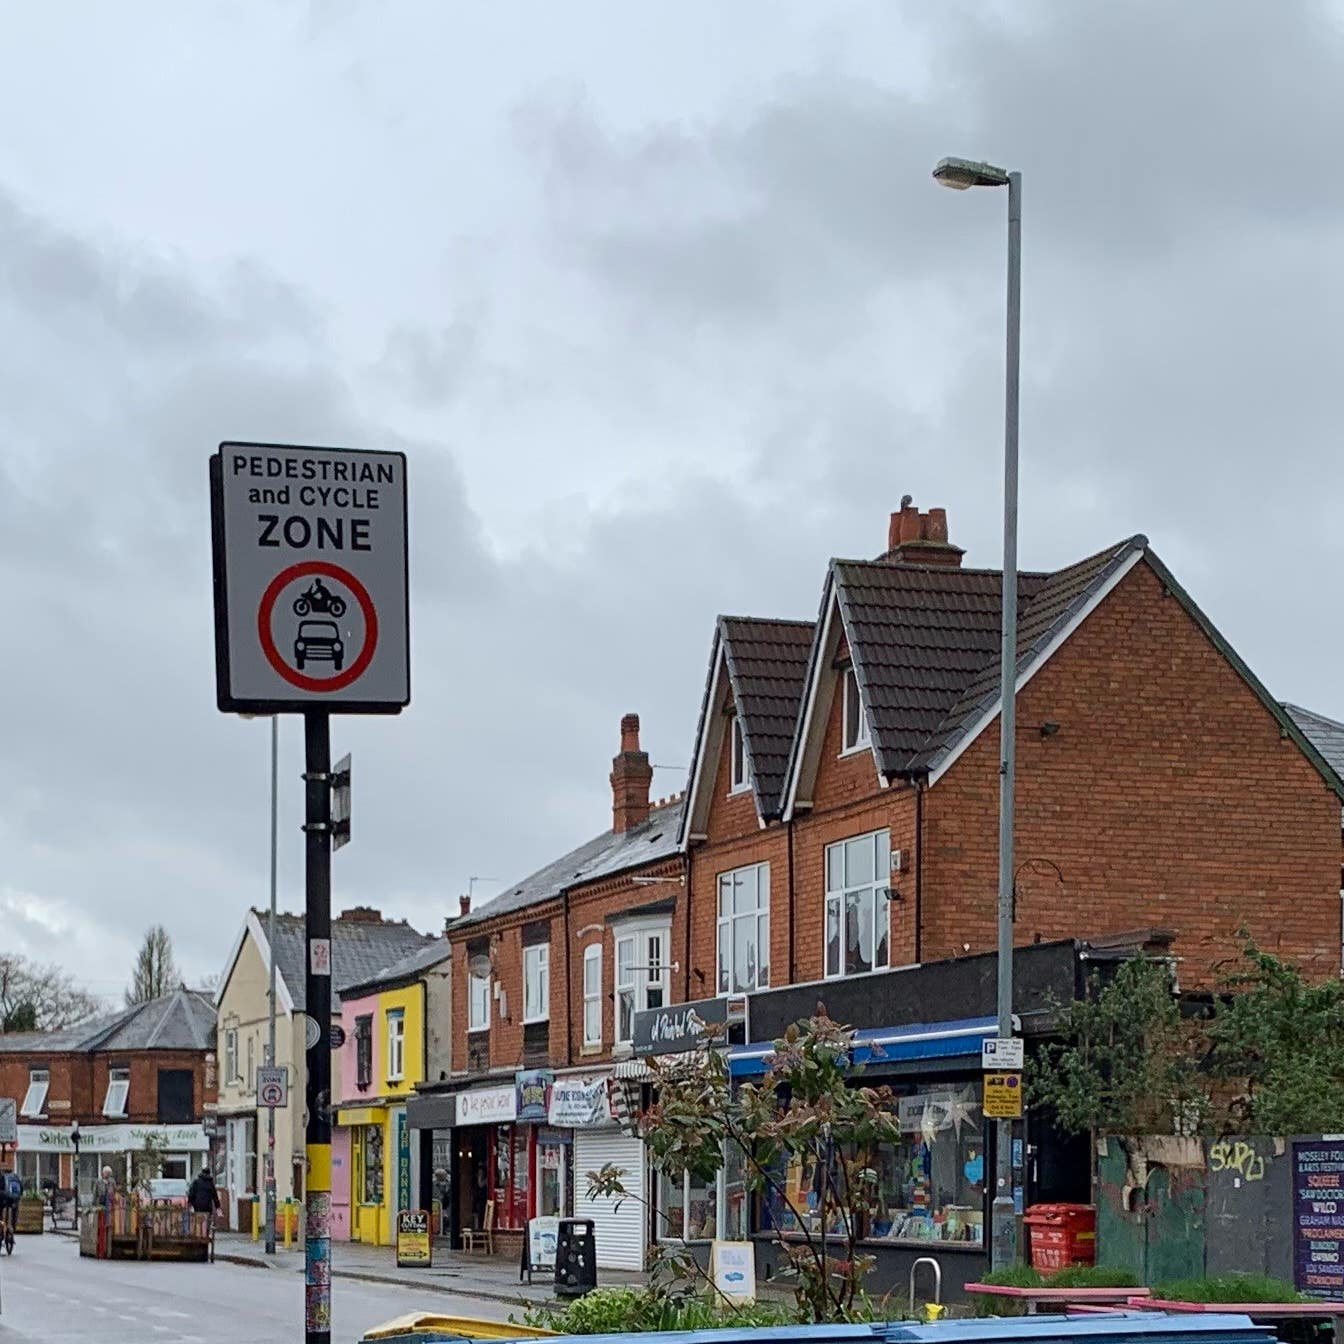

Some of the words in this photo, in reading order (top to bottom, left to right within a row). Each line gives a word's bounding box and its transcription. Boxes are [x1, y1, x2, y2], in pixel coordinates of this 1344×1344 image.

[233, 455, 394, 484] PEDESTRIAN
[248, 486, 290, 505] and
[300, 486, 380, 509] CYCLE
[258, 514, 372, 551] ZONE
[986, 1042, 996, 1054] P
[1311, 1202, 1338, 1213] WILCO
[402, 1214, 425, 1223] KEY
